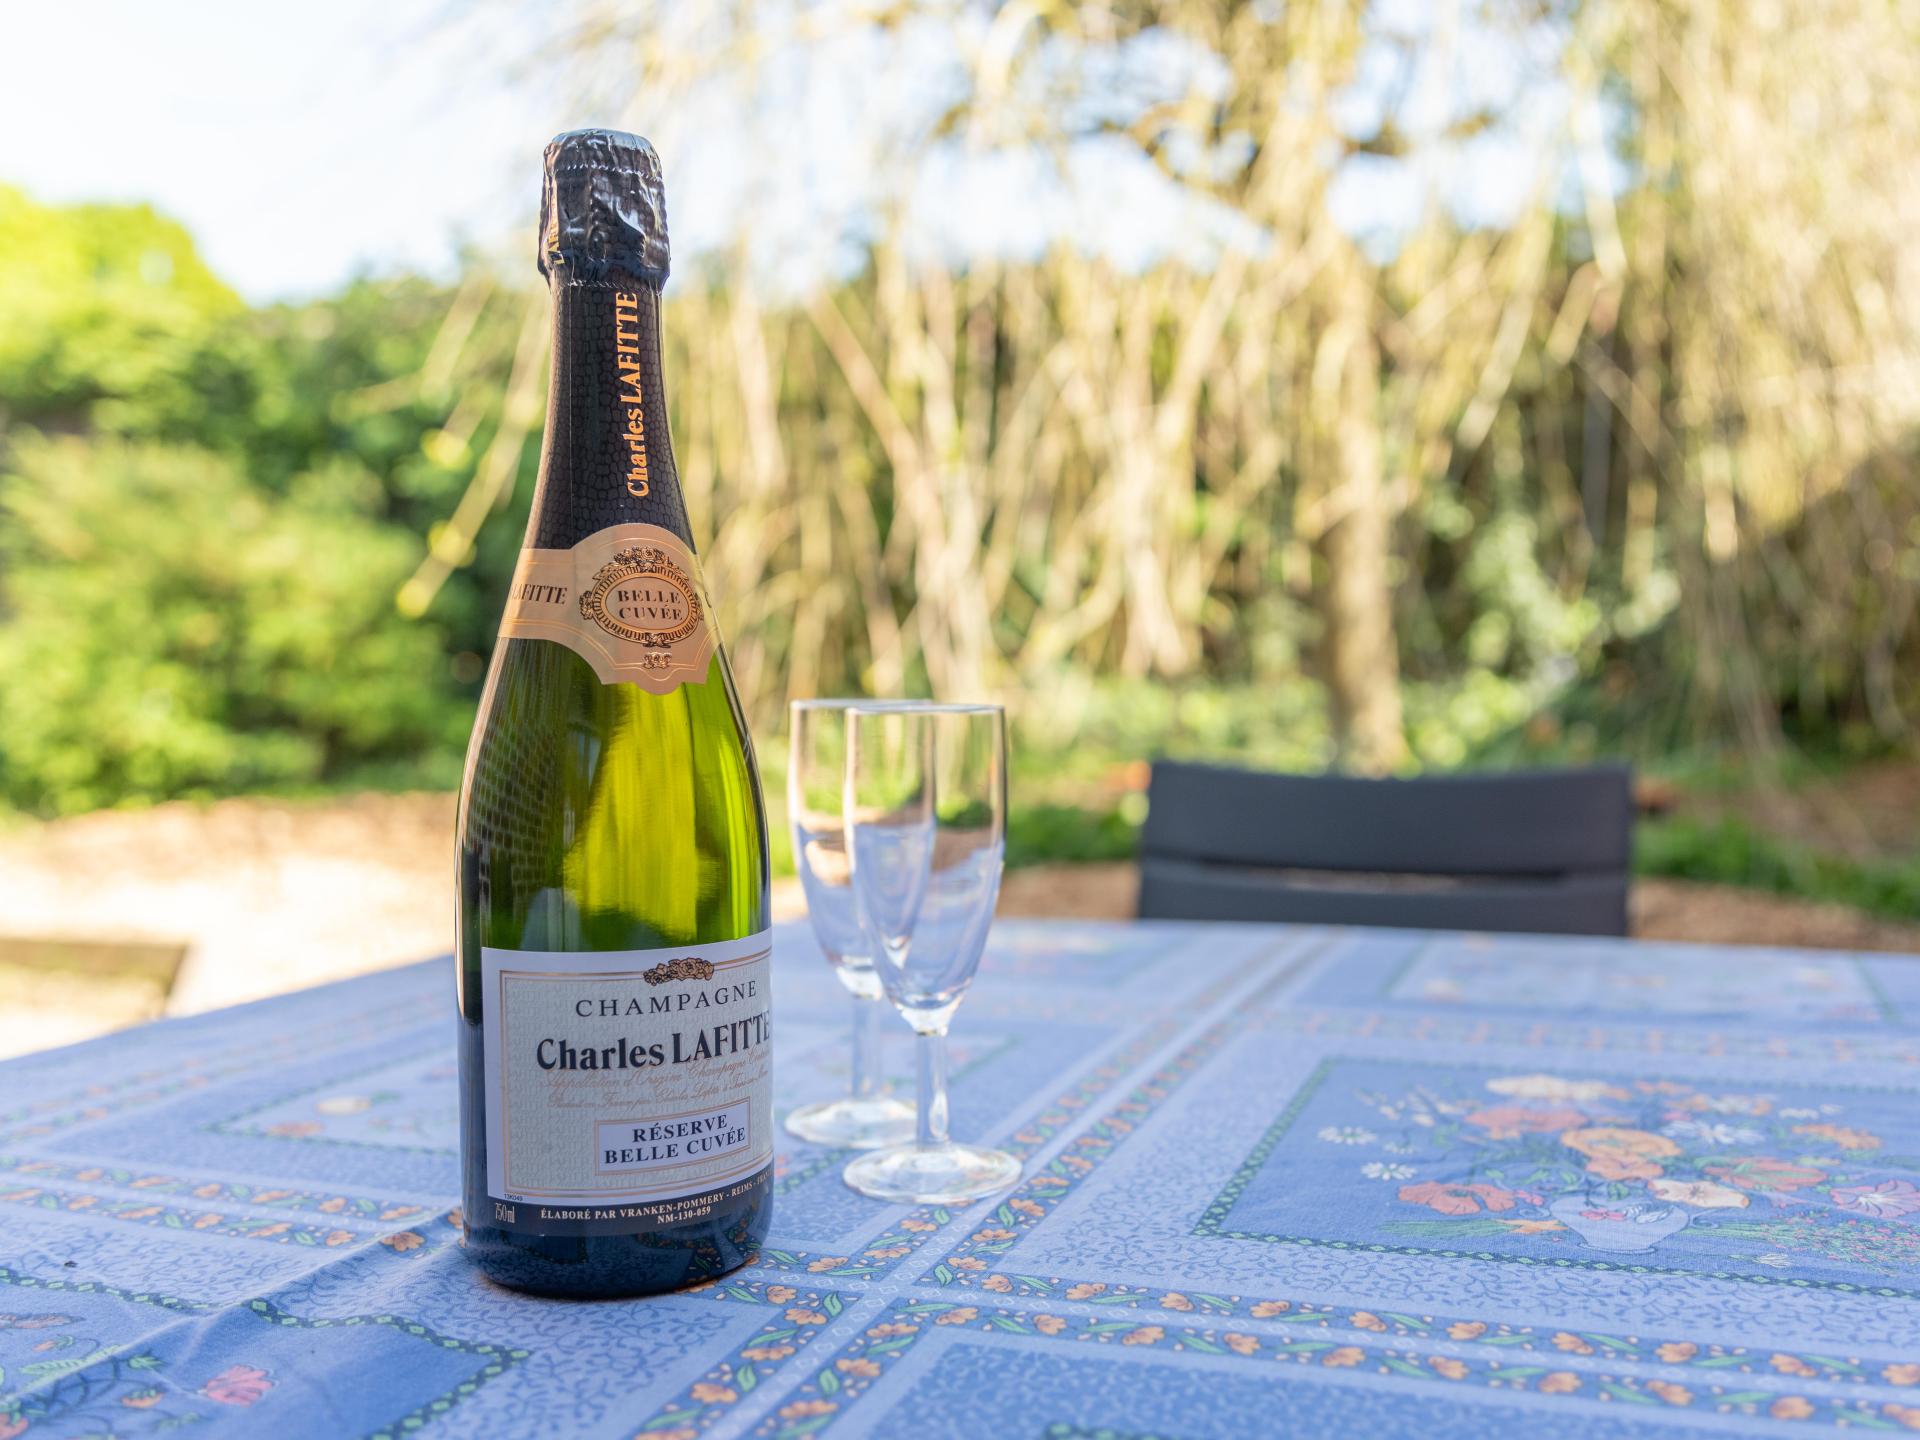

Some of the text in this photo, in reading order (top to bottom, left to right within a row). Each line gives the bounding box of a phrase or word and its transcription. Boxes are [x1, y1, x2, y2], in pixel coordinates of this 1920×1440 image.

[615, 291, 650, 497] Charles LAFITTE
[617, 589, 681, 604] BELLE
[618, 604, 683, 621] CUVÉE
[575, 980, 757, 1018] CHAMPAGNE
[536, 1037, 665, 1071] Charles
[671, 1009, 770, 1065] LAFITTE
[604, 1126, 746, 1164] BELLE CUVÉE
[632, 1114, 728, 1143] RÉSERVE
[540, 1207, 591, 1220] ÉLABORÉ
[595, 1210, 616, 1219] PAR
[620, 1191, 725, 1218] VRANKEN-POMMERY
[731, 1181, 753, 1197] REIMS
[657, 1206, 711, 1224] NM-130-059
